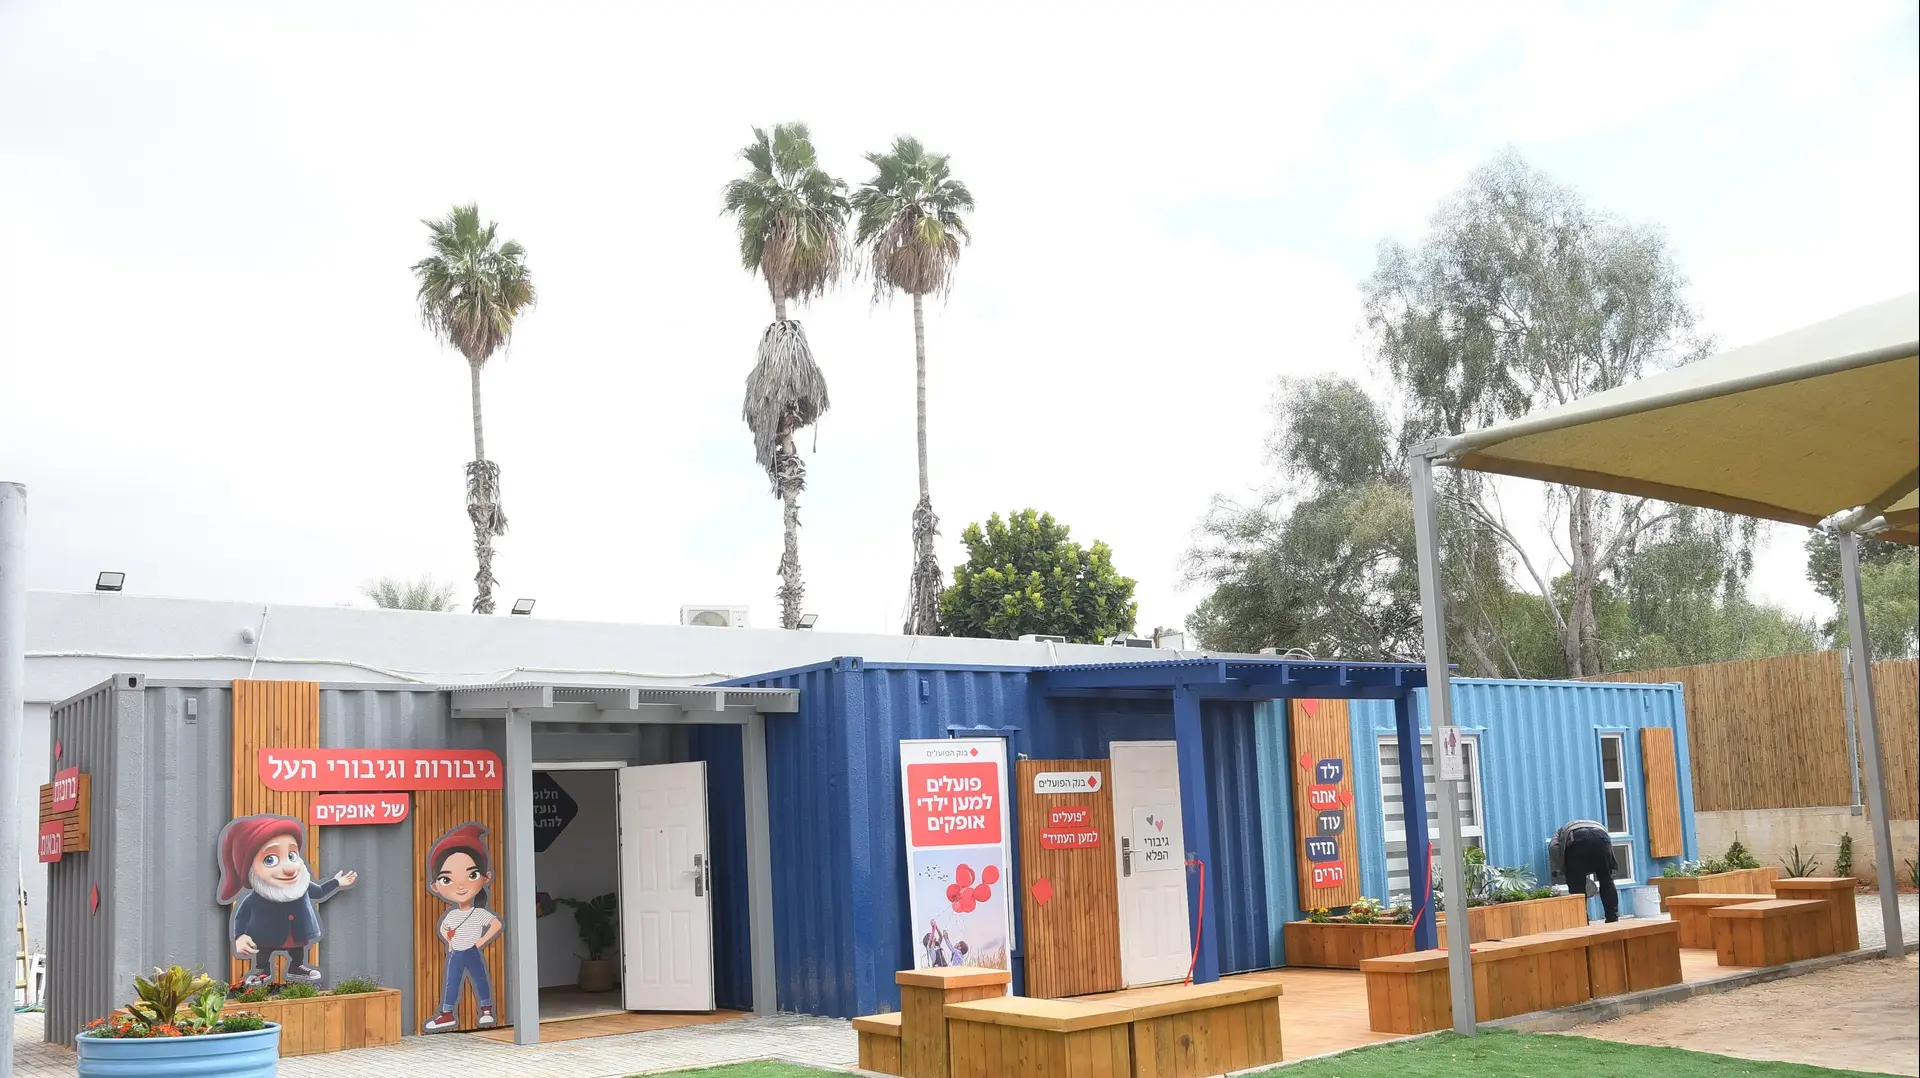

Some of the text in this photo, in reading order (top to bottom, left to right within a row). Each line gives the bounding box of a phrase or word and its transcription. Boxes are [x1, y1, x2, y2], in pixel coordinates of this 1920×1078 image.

[926, 749, 969, 758] בנק הפועלים
[268, 755, 496, 780] גיבורות וגיבורי העל
[1319, 763, 1340, 779] ילד
[926, 775, 982, 793] פועלים
[1038, 778, 1086, 788] בנק הפועלים
[917, 793, 993, 814] למען ילדי
[1311, 789, 1337, 804] אתה
[316, 801, 405, 822] של אופקים
[927, 814, 986, 834] אופקים
[1319, 816, 1341, 830] עוד
[1077, 831, 1098, 845] למען
[1143, 836, 1170, 847] גיבורי
[1145, 849, 1169, 862] הפלא
[1309, 841, 1336, 856] תזיז
[1314, 867, 1343, 883] הרים
